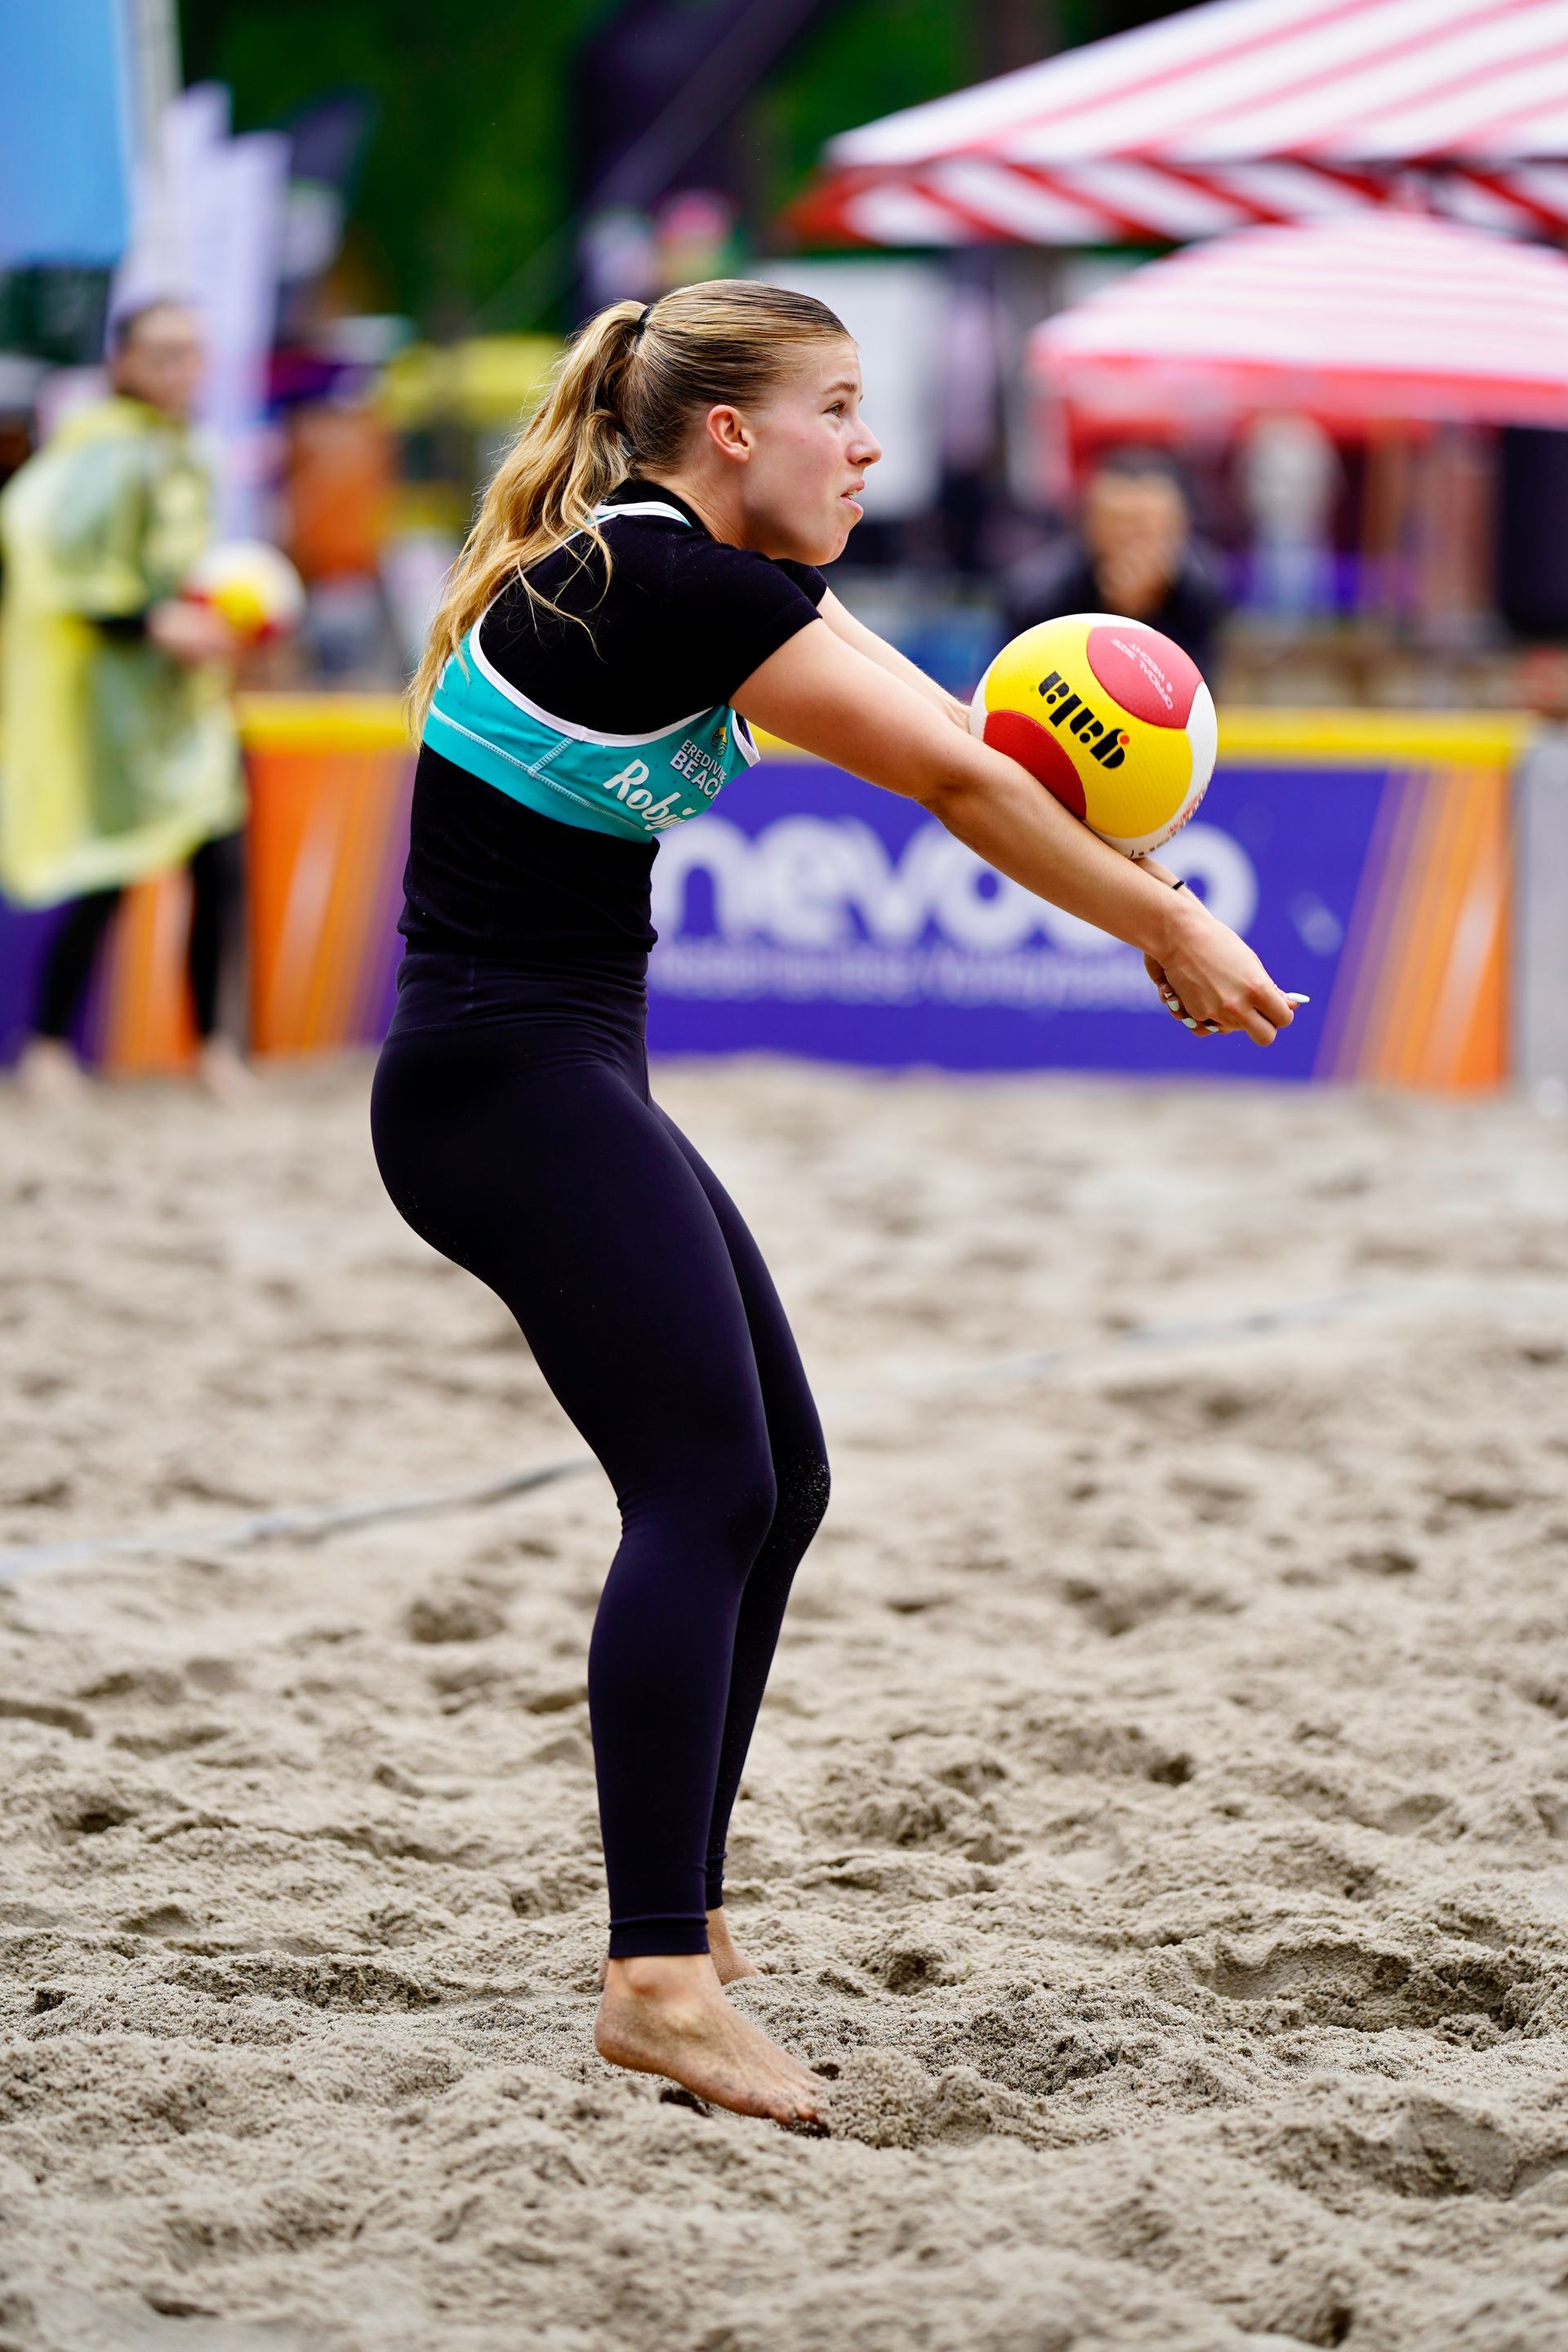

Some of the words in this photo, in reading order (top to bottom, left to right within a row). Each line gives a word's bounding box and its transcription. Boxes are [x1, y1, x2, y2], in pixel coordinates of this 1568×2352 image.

[1128, 642, 1165, 683] WEIGHT
[1139, 658, 1174, 710] OFFICIAL
[1038, 670, 1129, 769] gala
